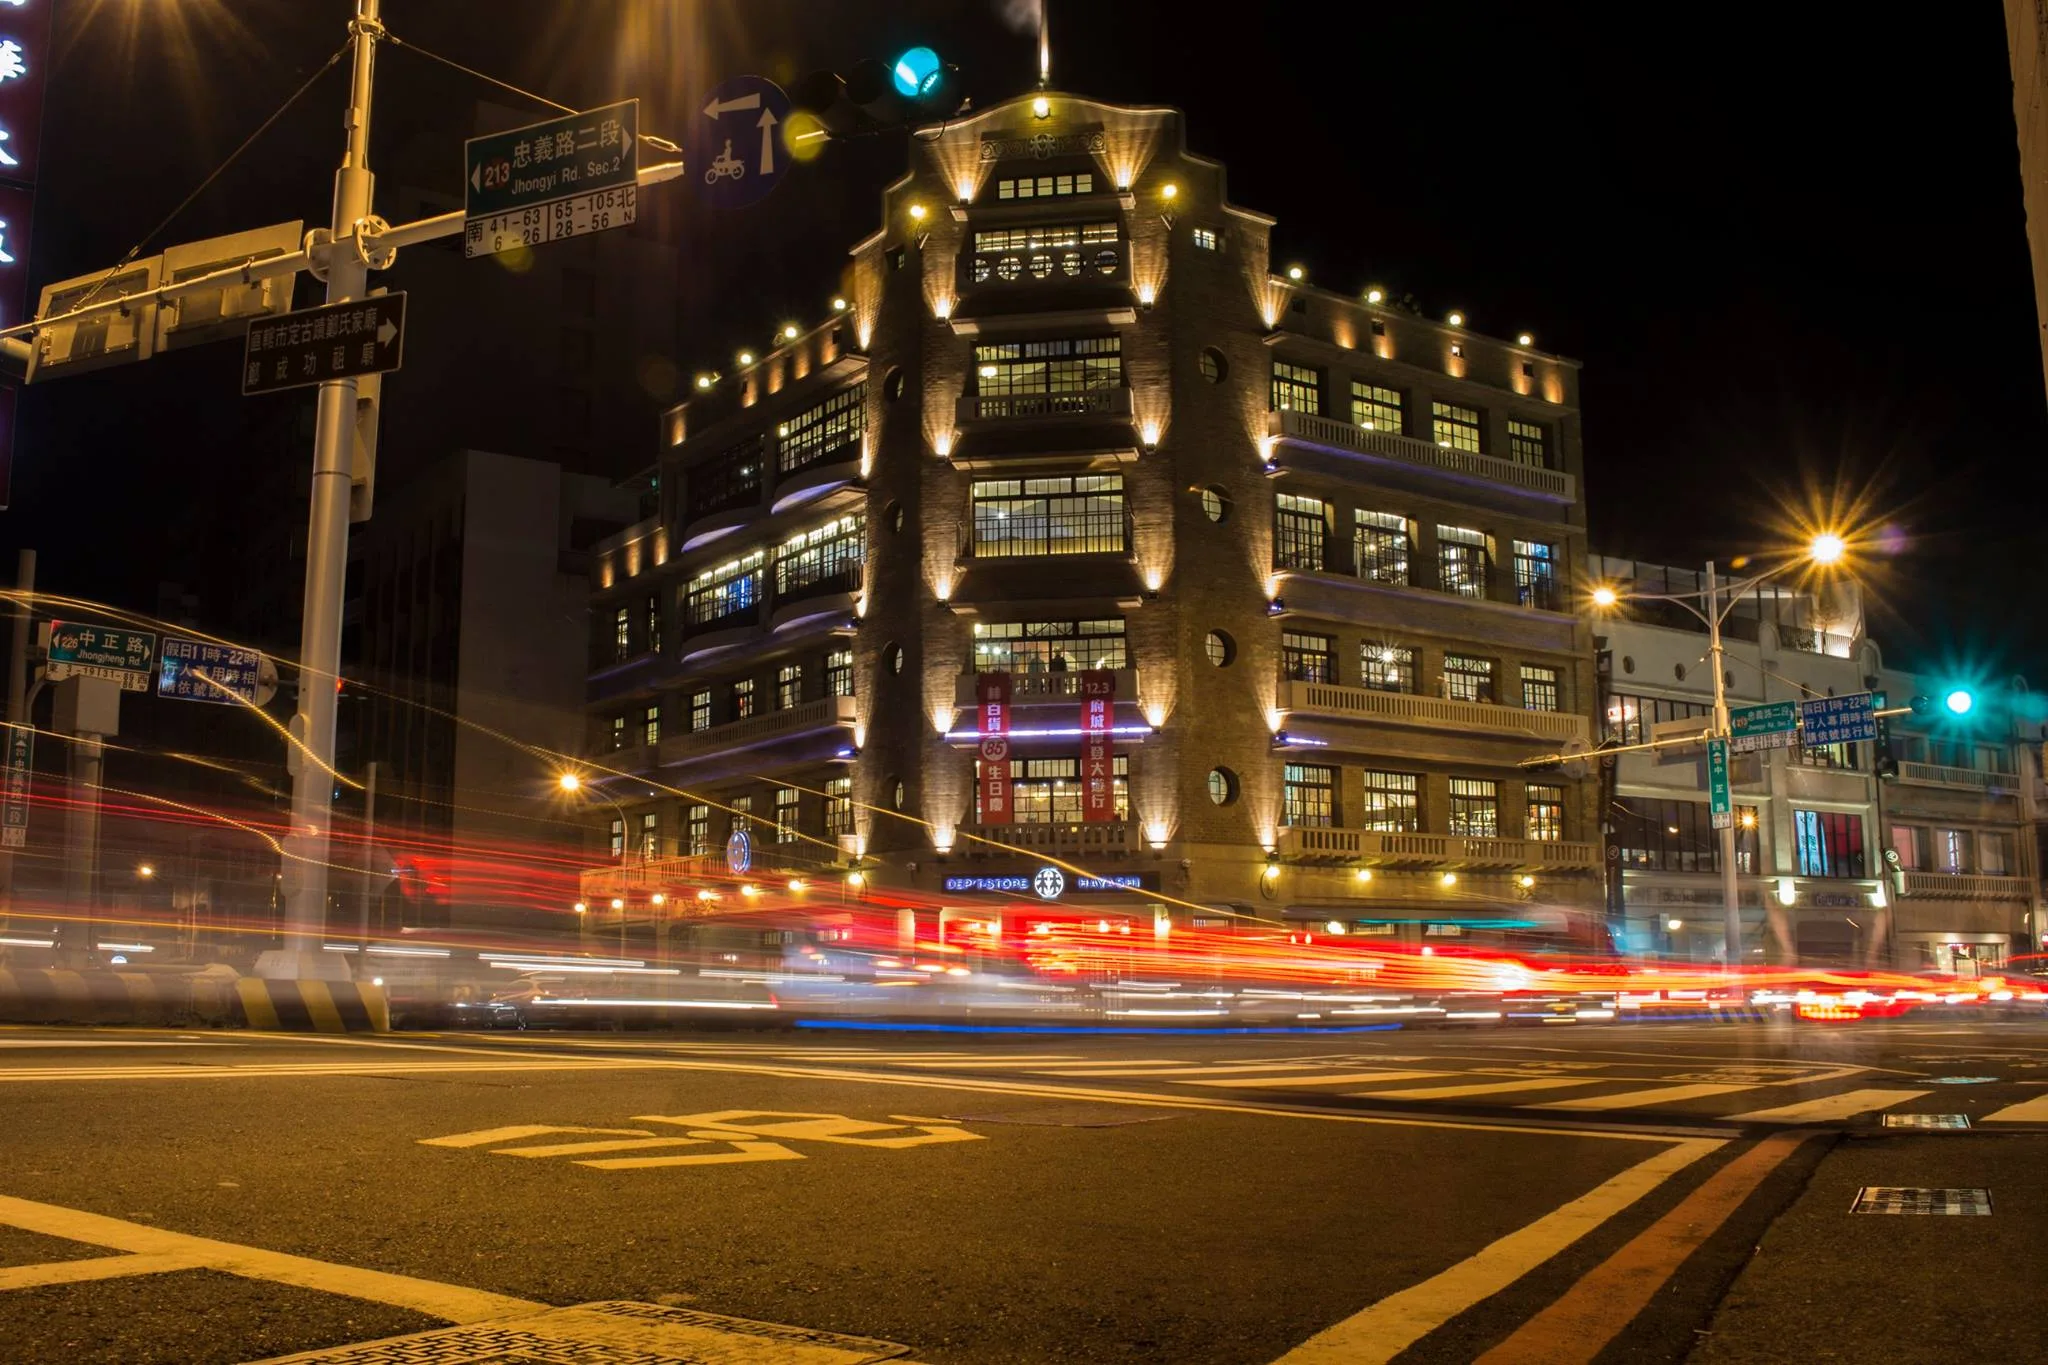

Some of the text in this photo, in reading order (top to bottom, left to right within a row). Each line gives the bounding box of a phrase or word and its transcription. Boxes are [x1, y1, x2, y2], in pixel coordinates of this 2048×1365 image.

[484, 119, 621, 187] 213 忠義路二段
[511, 156, 620, 195] Jhongyi Rd. Sec.2
[467, 222, 483, 244] 南
[617, 188, 635, 208] 北
[61, 629, 144, 653] 226 中正路
[166, 642, 258, 667] 假日11時-22時
[1086, 682, 1110, 694] 12.3
[1804, 696, 1870, 714] 假日11時-22時
[1805, 711, 1874, 729] 行人專用時相
